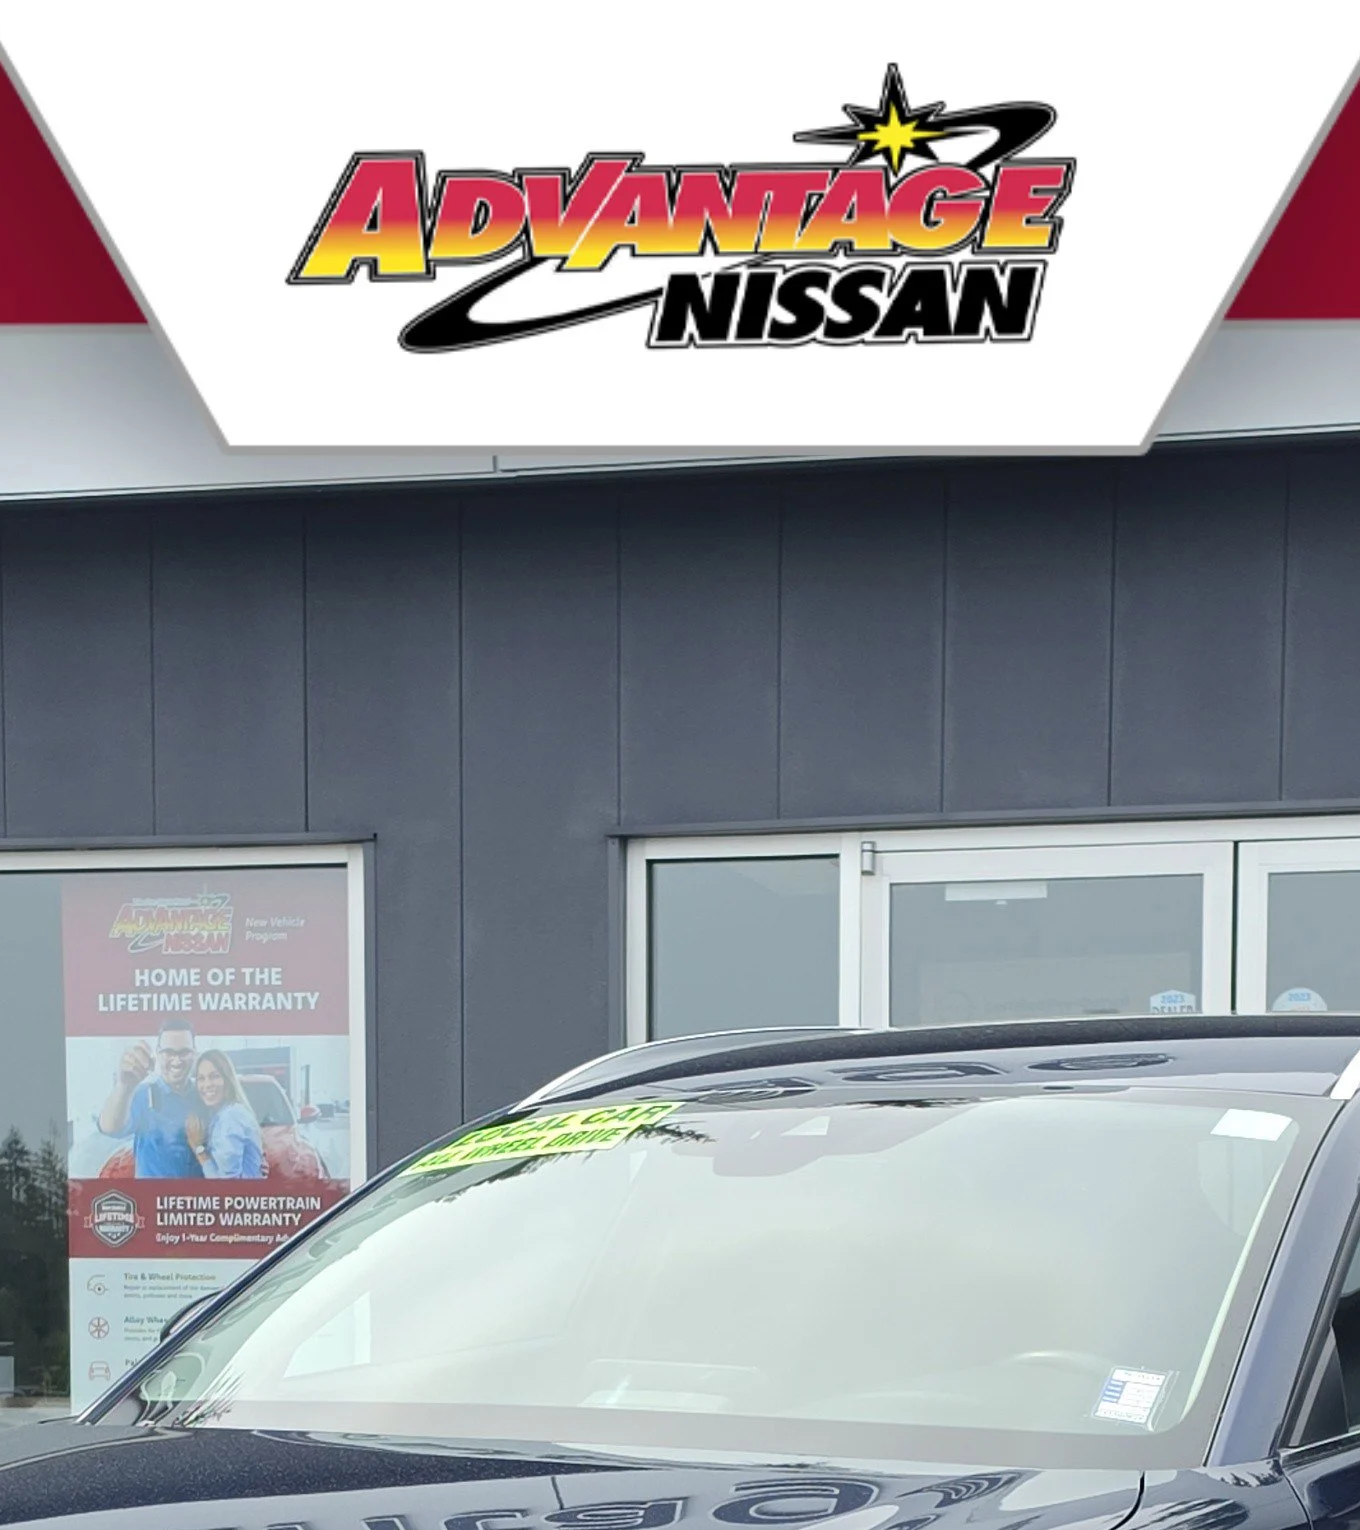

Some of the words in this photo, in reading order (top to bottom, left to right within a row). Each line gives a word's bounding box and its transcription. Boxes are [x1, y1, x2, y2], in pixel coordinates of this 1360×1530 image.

[245, 917, 268, 928] New
[245, 931, 288, 944] Program
[134, 968, 201, 987] HOME
[206, 968, 235, 986] OF
[241, 967, 282, 986] THE
[98, 993, 192, 1012] LIFETIME
[198, 992, 320, 1012] WARRANTY
[581, 1104, 673, 1126] CAR
[544, 1127, 628, 1149] DRIVE
[156, 1196, 220, 1210] LIFETIME
[224, 1196, 321, 1211] POWERTRAIN
[156, 1212, 215, 1226] LIMITED
[219, 1212, 301, 1226] WARRANTY
[155, 1233, 180, 1245] Enjoy
